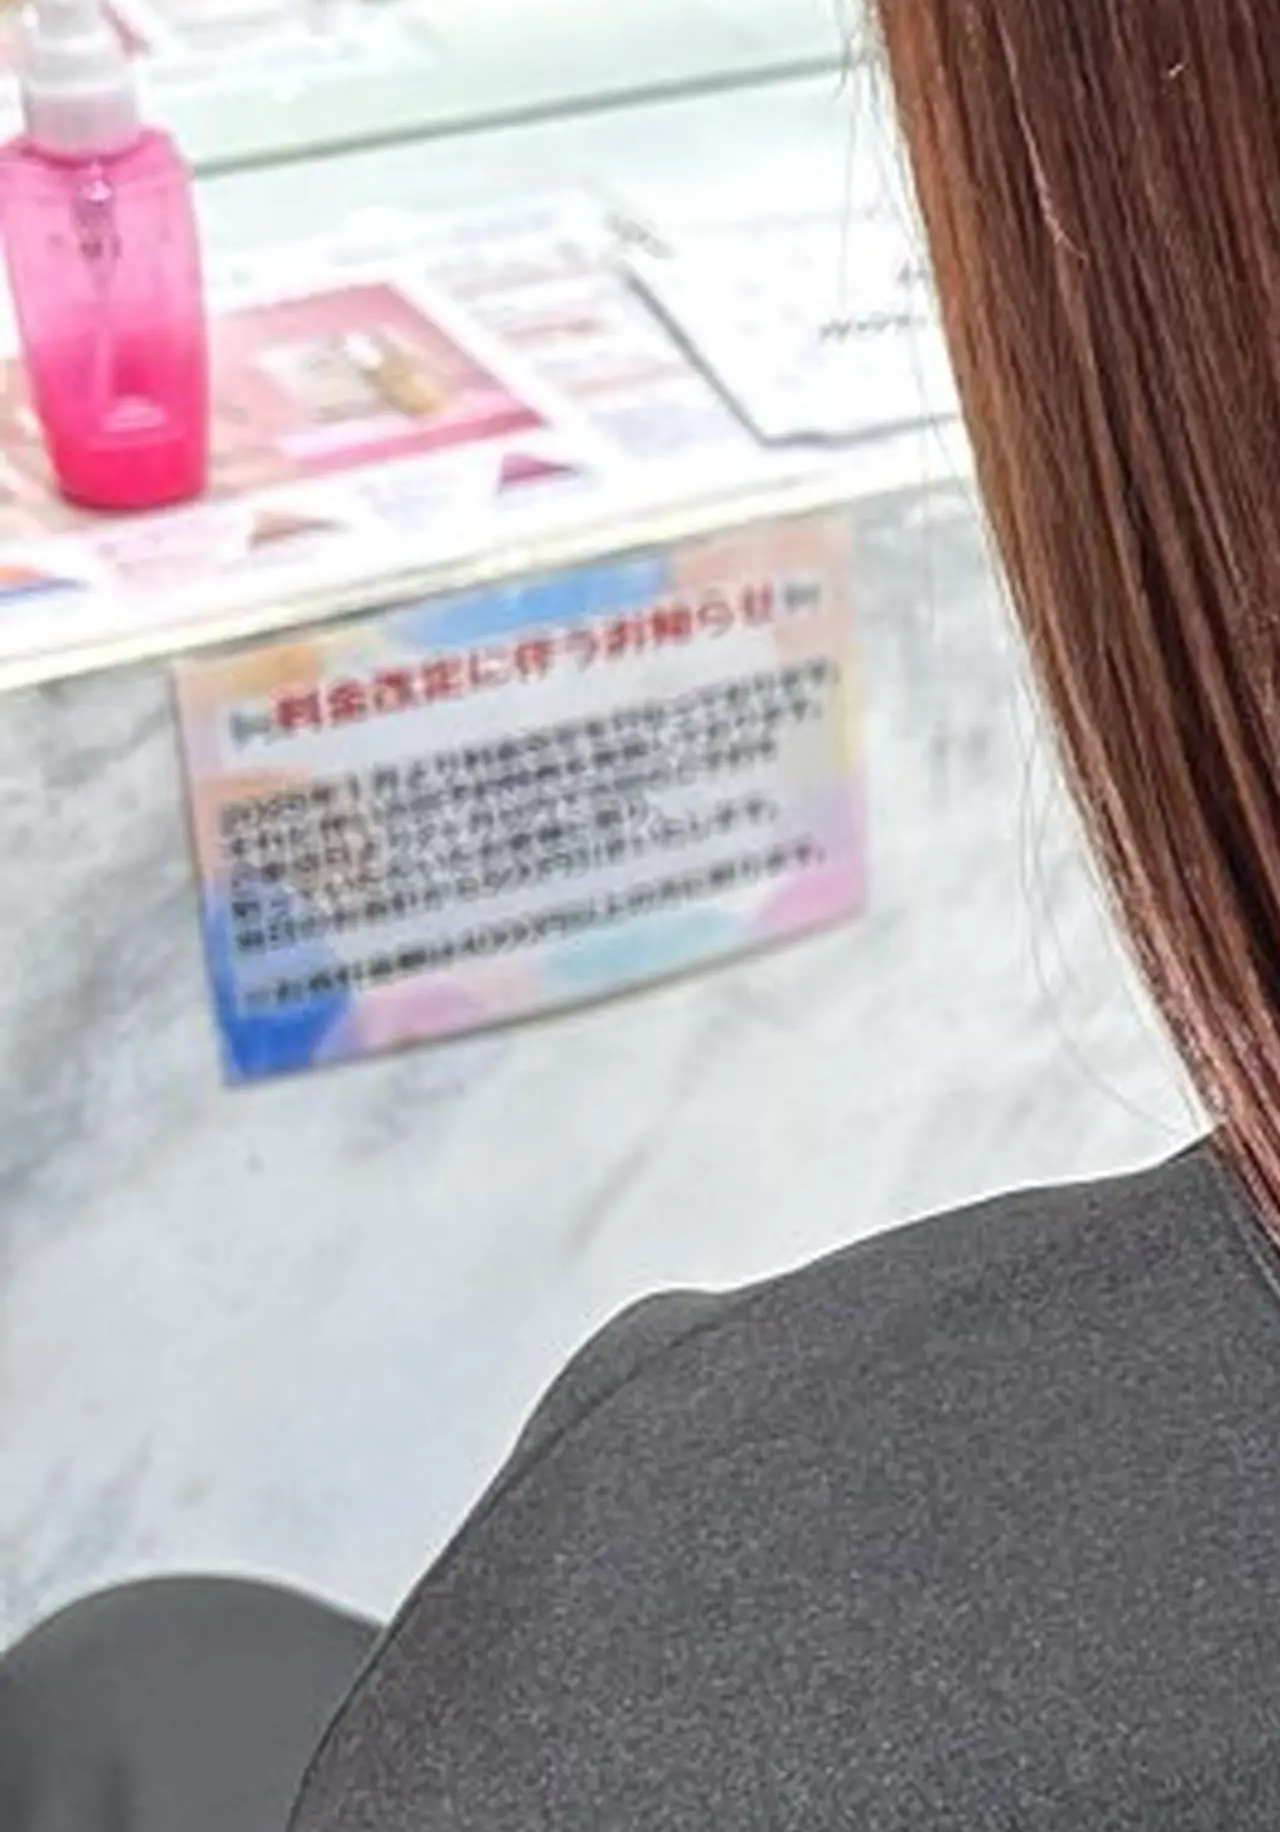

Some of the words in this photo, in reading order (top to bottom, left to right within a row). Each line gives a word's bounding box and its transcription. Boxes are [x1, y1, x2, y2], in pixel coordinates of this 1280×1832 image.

[273, 581, 775, 733] 料金改定に伴うお知らせ
